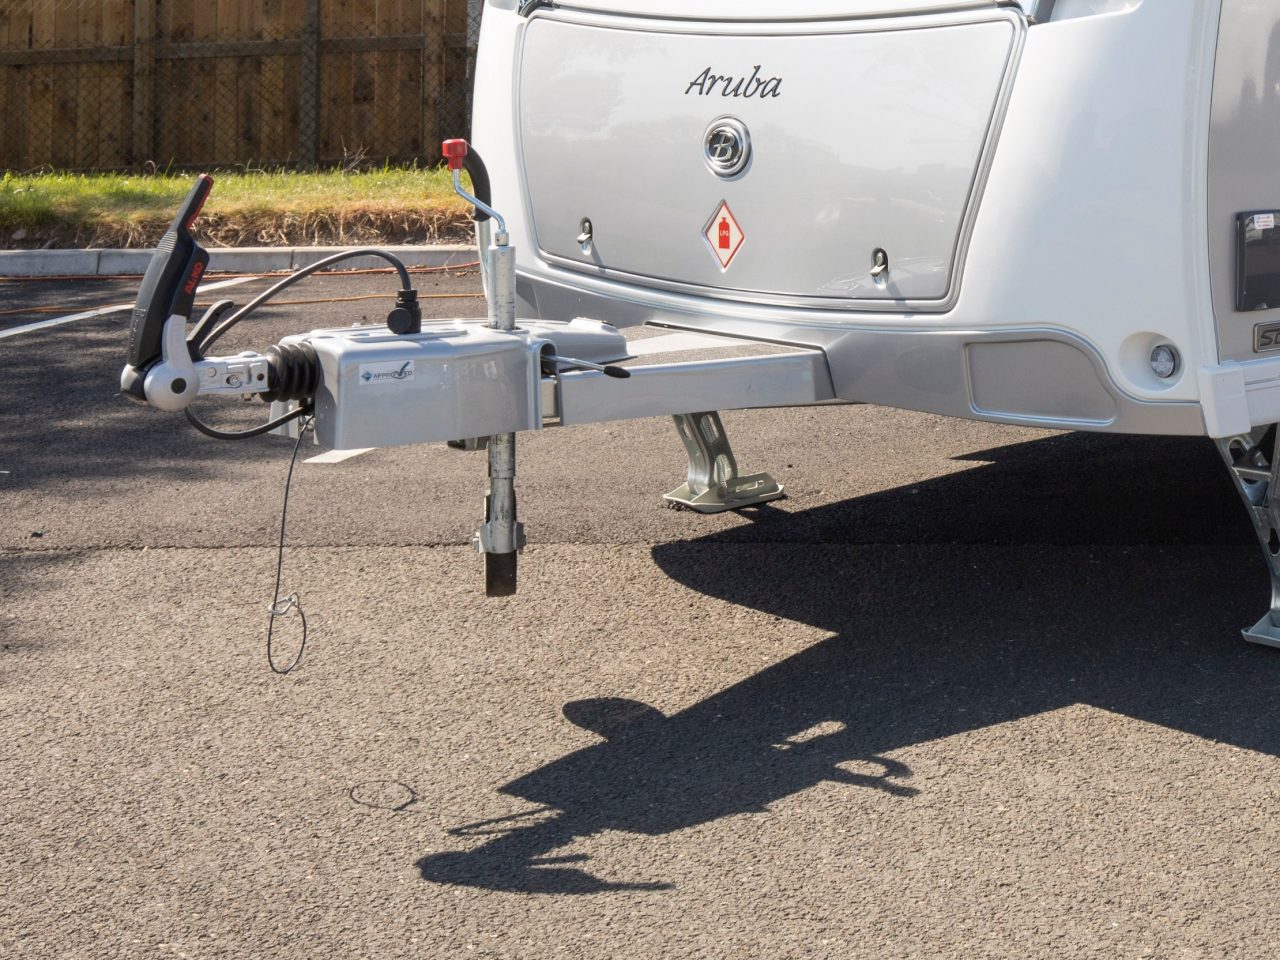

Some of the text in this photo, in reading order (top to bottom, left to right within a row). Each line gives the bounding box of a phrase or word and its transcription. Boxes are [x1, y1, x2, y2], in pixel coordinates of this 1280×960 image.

[684, 65, 783, 99] Aruba
[712, 131, 736, 162] B
[719, 229, 730, 238] LPG
